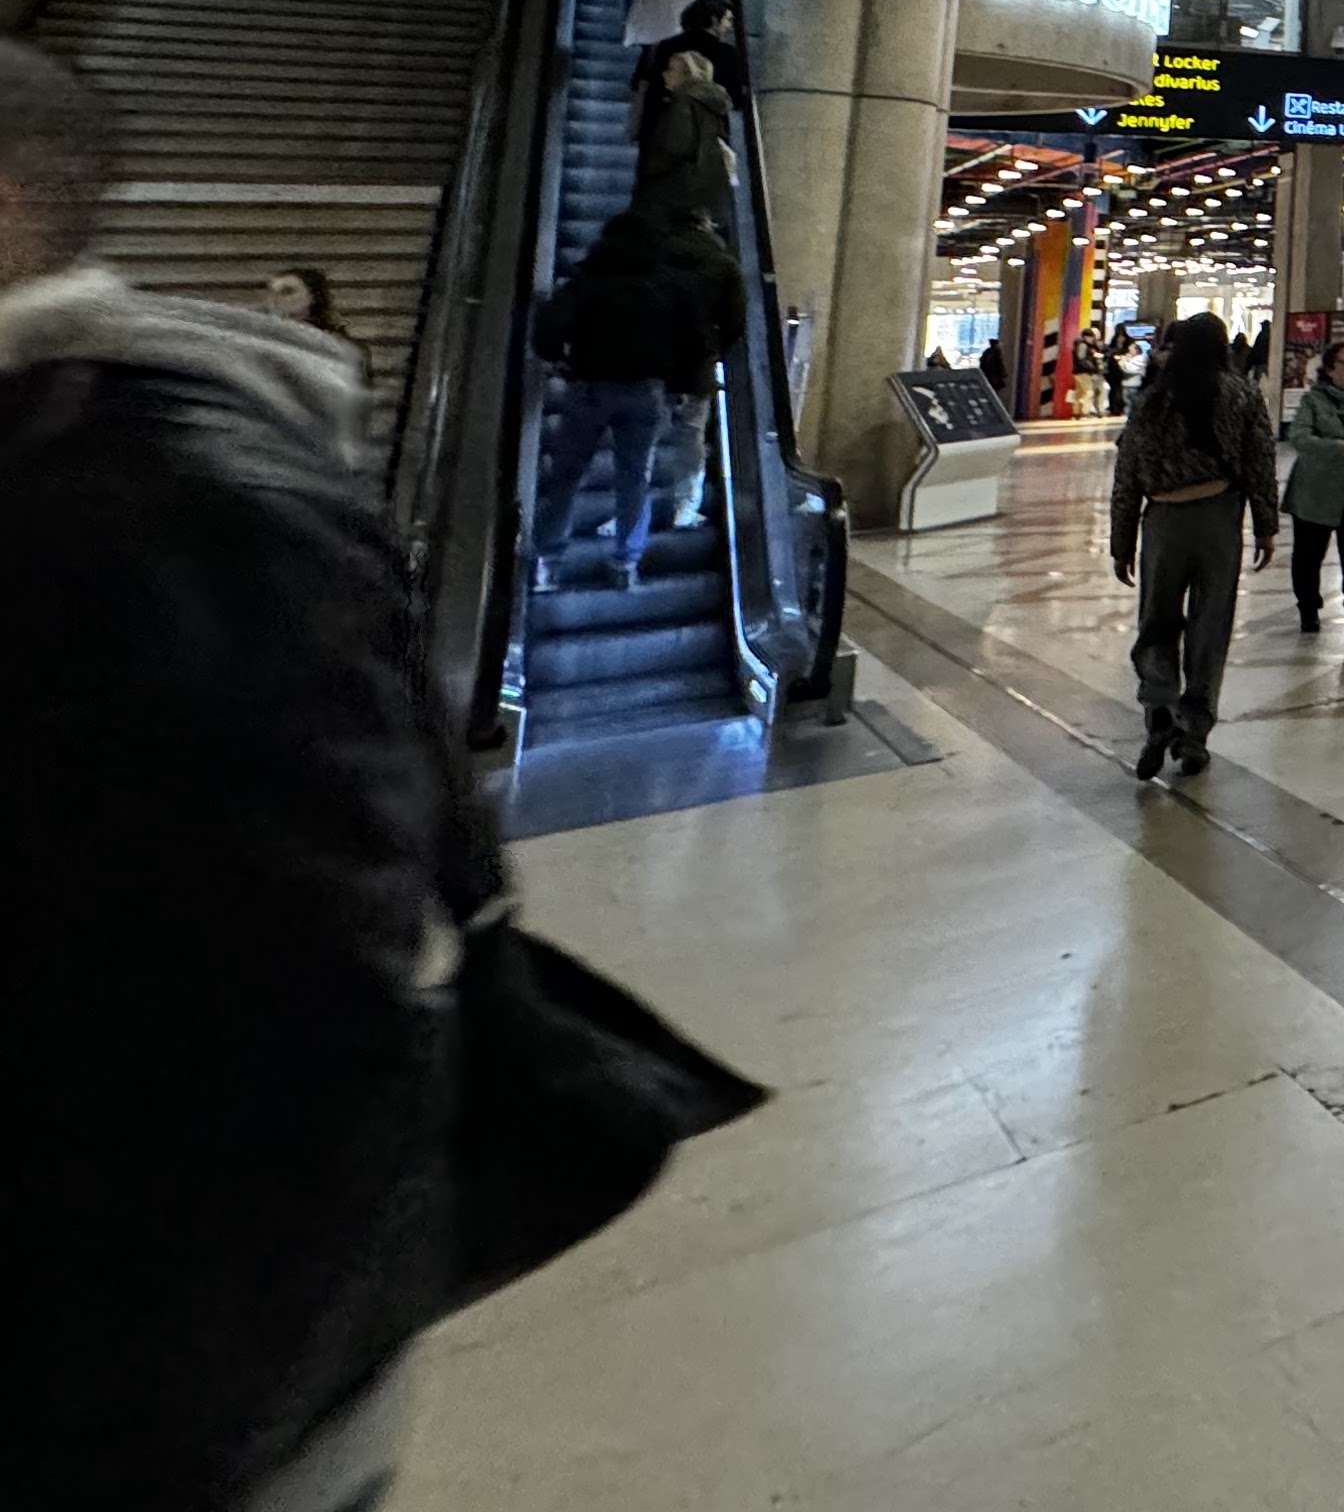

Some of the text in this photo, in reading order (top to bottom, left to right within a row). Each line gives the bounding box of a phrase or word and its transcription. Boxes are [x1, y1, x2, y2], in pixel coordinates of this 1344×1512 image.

[1163, 54, 1221, 72] Locker
[1117, 113, 1195, 132] Jennyfer
[1283, 120, 1336, 136] Cinéma
